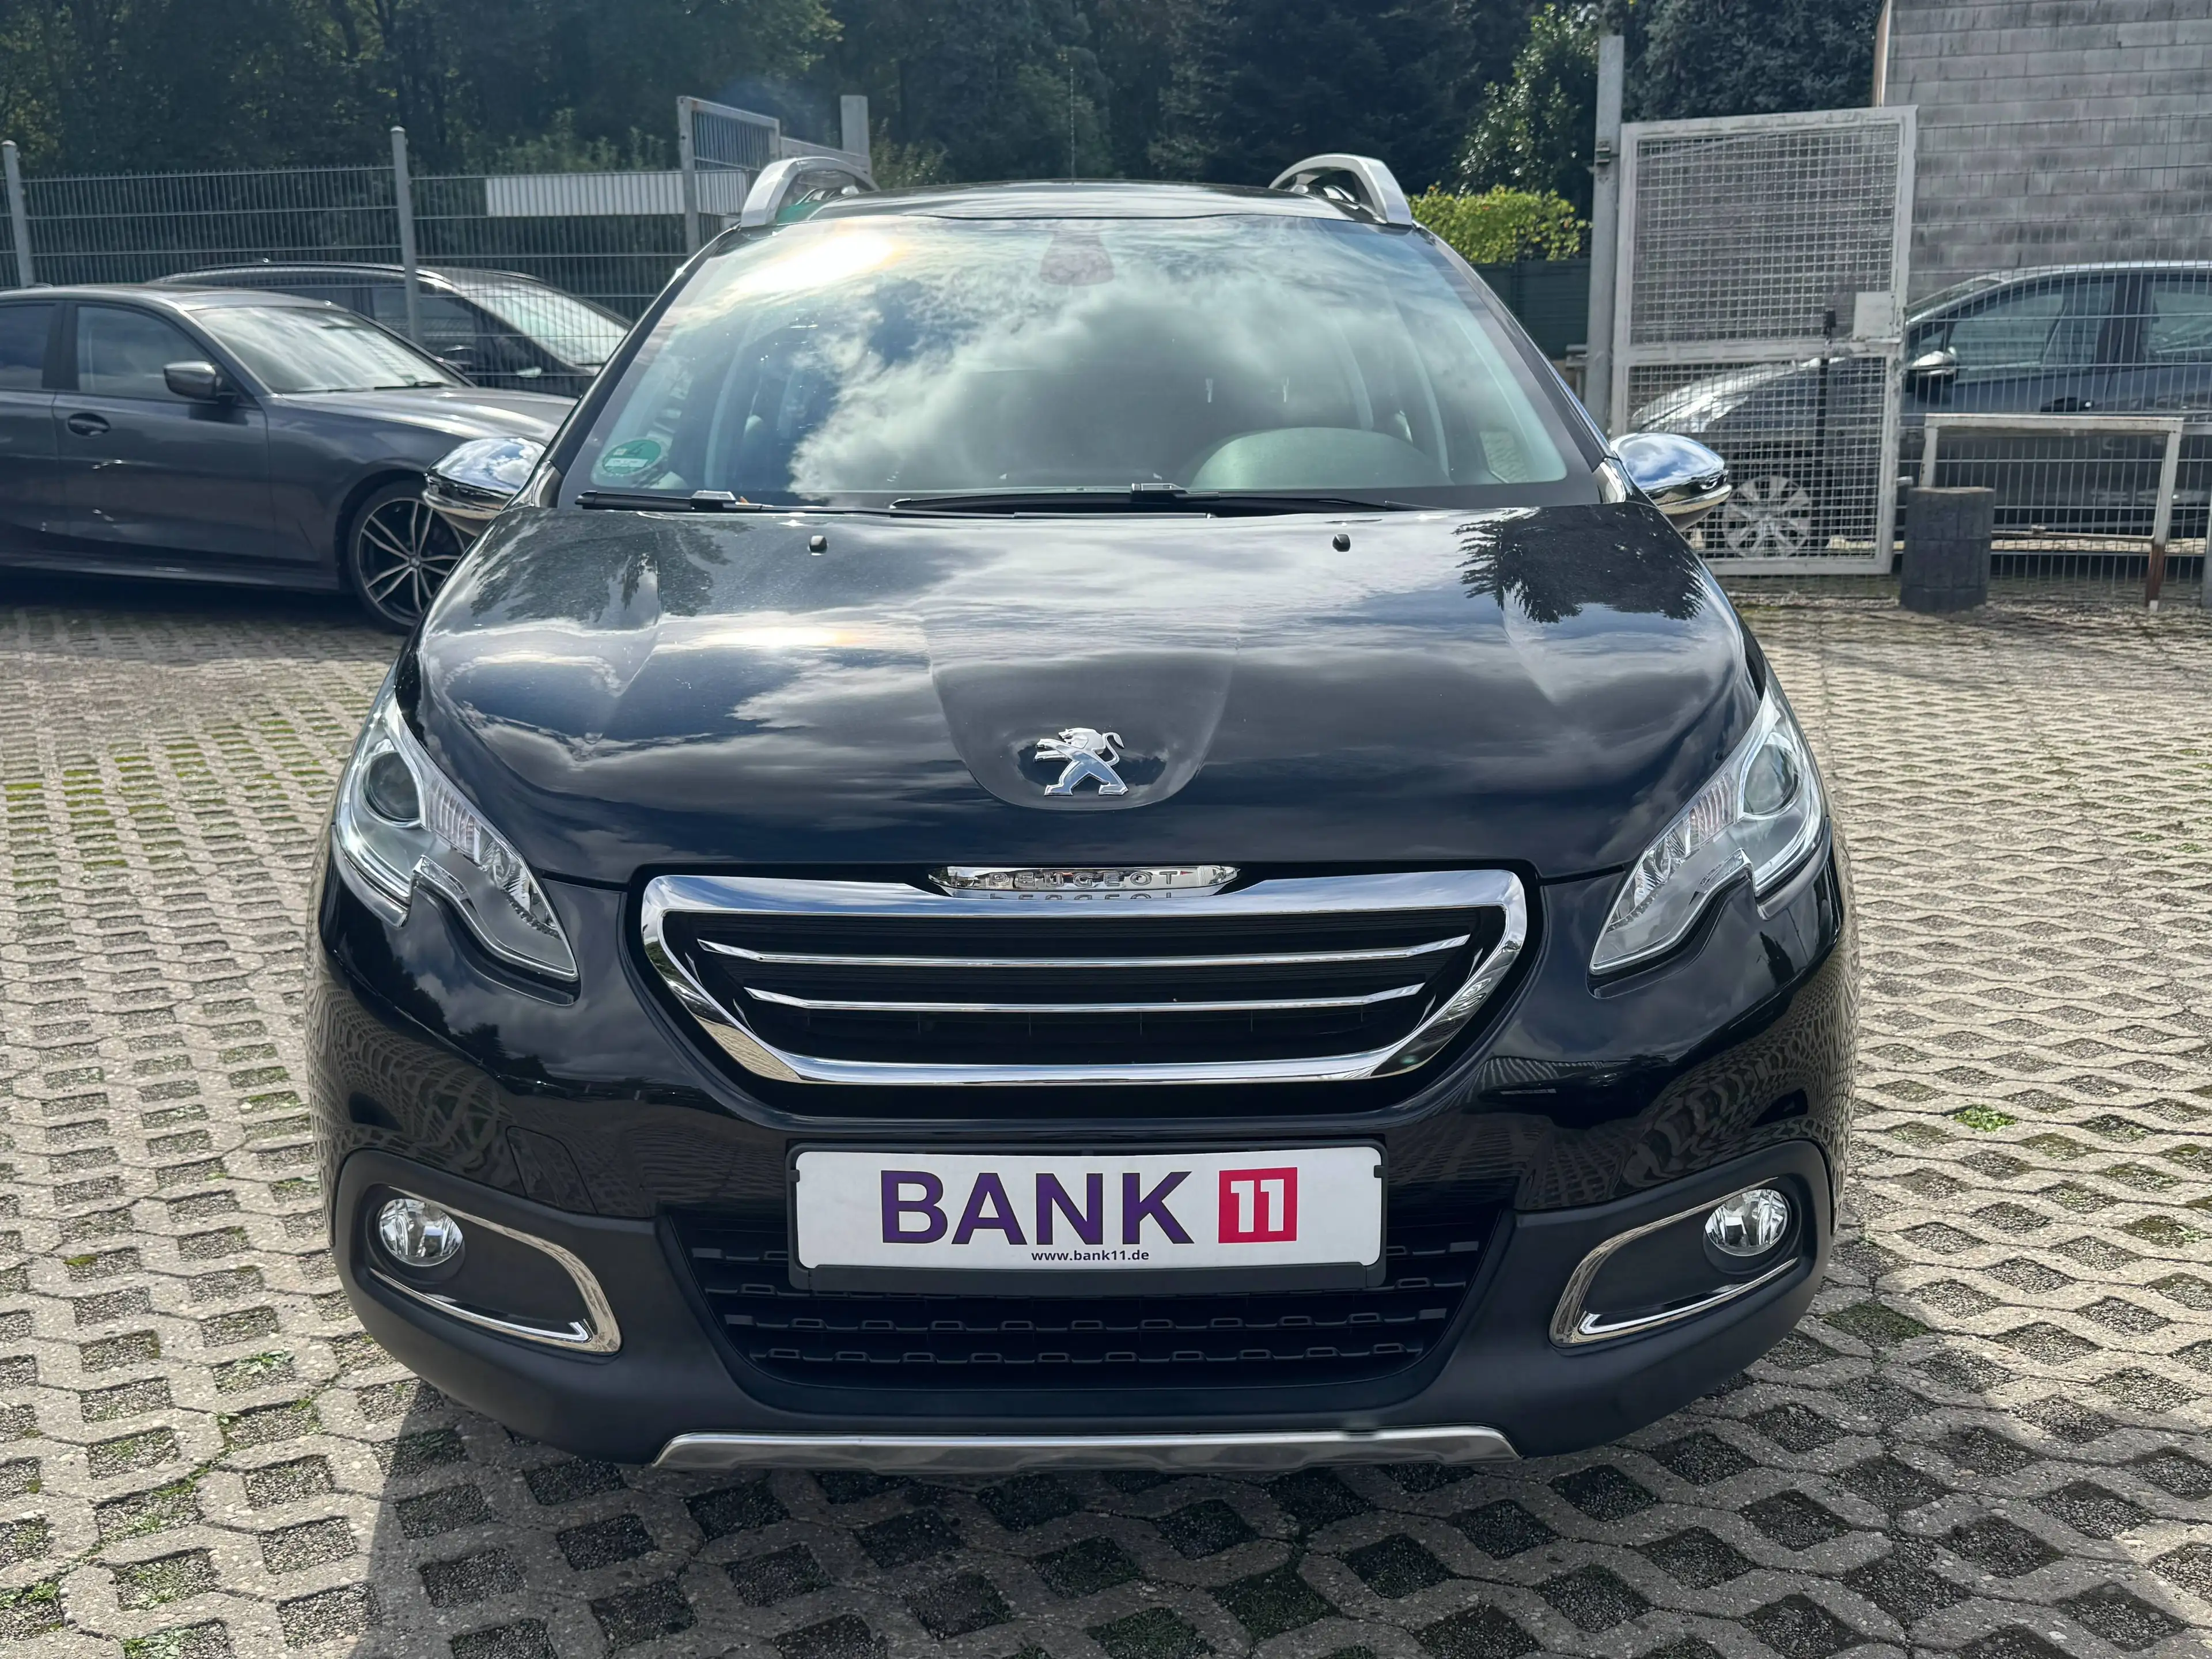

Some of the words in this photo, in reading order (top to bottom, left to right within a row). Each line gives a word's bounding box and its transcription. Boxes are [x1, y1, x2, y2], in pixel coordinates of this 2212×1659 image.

[989, 870, 1178, 888] PEUGEOT
[881, 1171, 1195, 1245] BANK
[1230, 1178, 1286, 1233] 11
[1031, 1249, 1150, 1262] www.bank11.de
